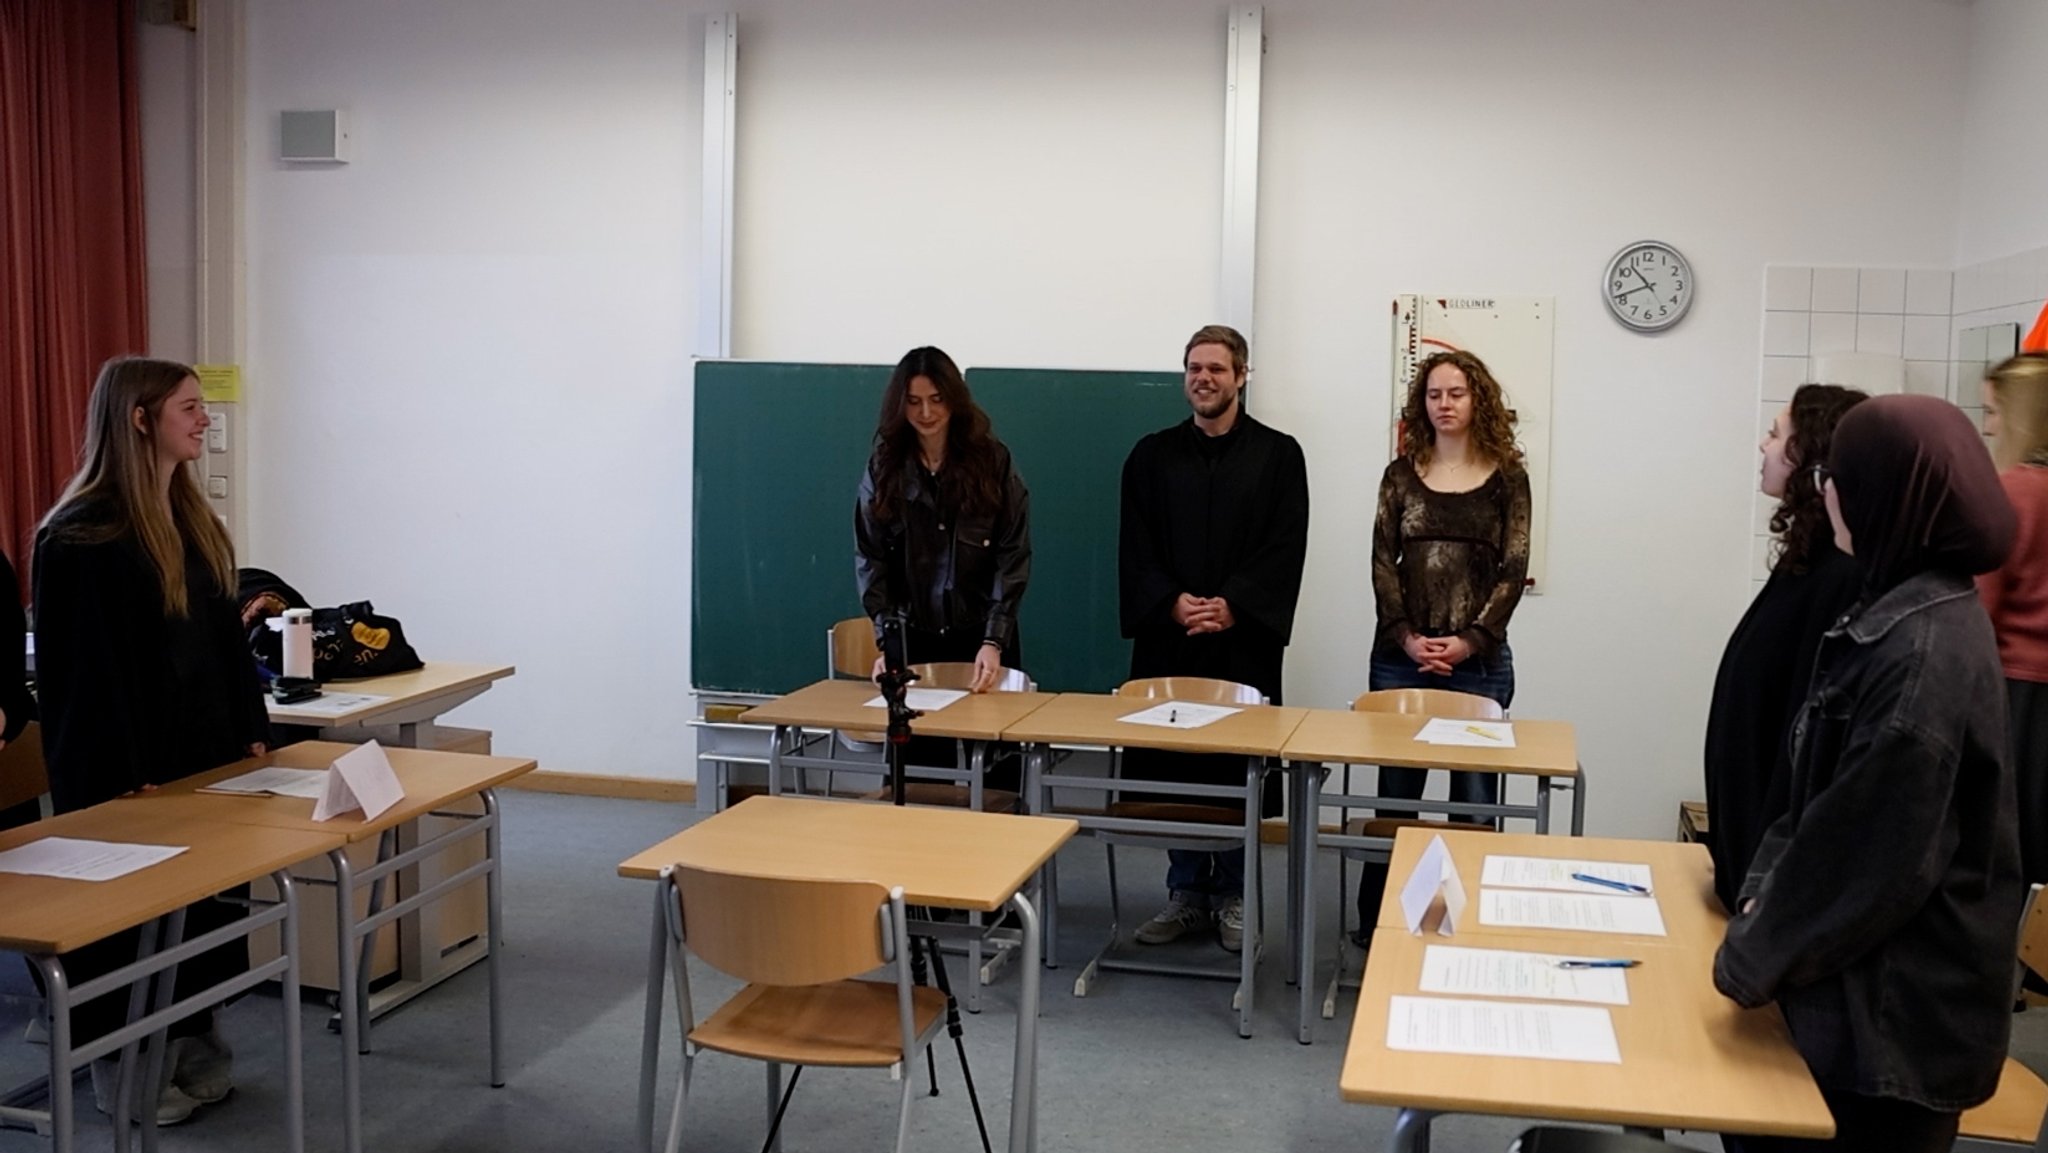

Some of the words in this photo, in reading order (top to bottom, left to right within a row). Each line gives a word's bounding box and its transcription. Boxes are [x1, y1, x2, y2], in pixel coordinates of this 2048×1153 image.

[1630, 256, 1640, 267] 11
[1642, 251, 1655, 263] 12
[1619, 267, 1632, 278] 10
[1670, 265, 1679, 277] 2
[1614, 280, 1623, 291] 9
[1675, 280, 1684, 291] 3
[1618, 294, 1628, 306] 8
[1669, 295, 1678, 305] 4
[1630, 305, 1639, 316] 7
[1643, 309, 1653, 320] 6
[1659, 305, 1668, 316] 5
